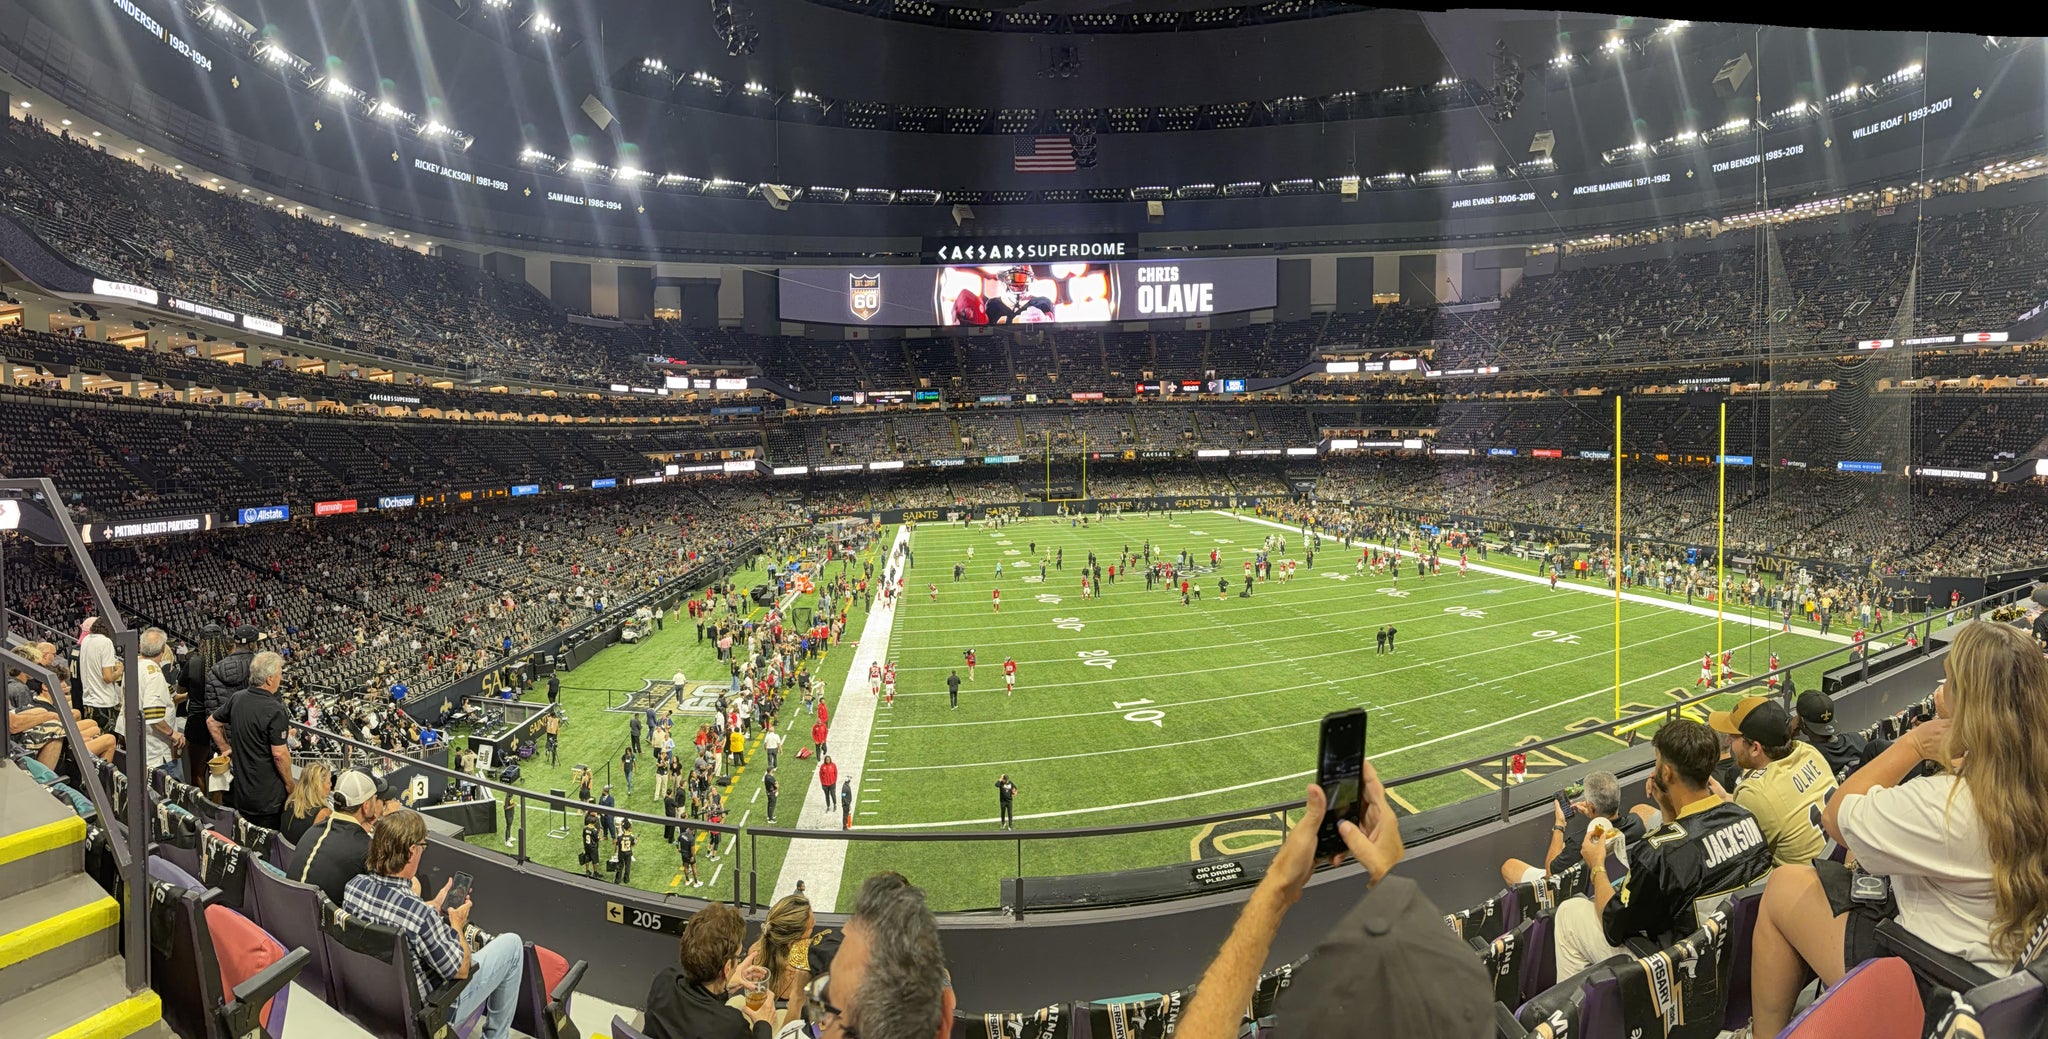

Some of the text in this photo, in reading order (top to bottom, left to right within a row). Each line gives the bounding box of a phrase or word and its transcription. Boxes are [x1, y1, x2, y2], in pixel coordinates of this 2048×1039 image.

[169, 34, 212, 71] 1982-1994
[1852, 98, 1952, 139] WILLIE ROAF 1993-2001
[1712, 145, 1804, 172] TOM BENSON 1985-2018
[415, 159, 508, 191] RICKEY JACKSON 1981-1993
[1573, 174, 1670, 195] ARCHIE MANNING 1971-1982
[548, 192, 621, 210] SAM MILLS 1986-1994
[1452, 193, 1535, 209] JAHRI EVANS 2006-2016
[938, 243, 1125, 260] CAESARS SUPERDOME
[1138, 266, 1179, 283] CHRIS
[854, 294, 877, 309] 60
[1138, 283, 1214, 314] OLAVE
[75, 356, 106, 370] SAINTS
[140, 365, 168, 378] SAINTS
[935, 458, 965, 467] Ochsner
[1584, 451, 1609, 459] Ochsner
[384, 496, 414, 508] Ochsner
[256, 509, 284, 520] Allstate
[902, 510, 938, 521] SAINTS
[114, 518, 199, 538] PATRON SAINTS PARTNERS
[1077, 650, 1117, 667] 20
[1113, 698, 1165, 723] 10
[1792, 759, 1821, 794] OLAVE
[416, 781, 425, 797] 3
[1702, 816, 1763, 868] JACKSON
[1197, 862, 1234, 874] NO FOOD
[1210, 867, 1241, 877] DRINKS
[1205, 873, 1238, 884] PLEASE
[632, 910, 661, 930] 205
